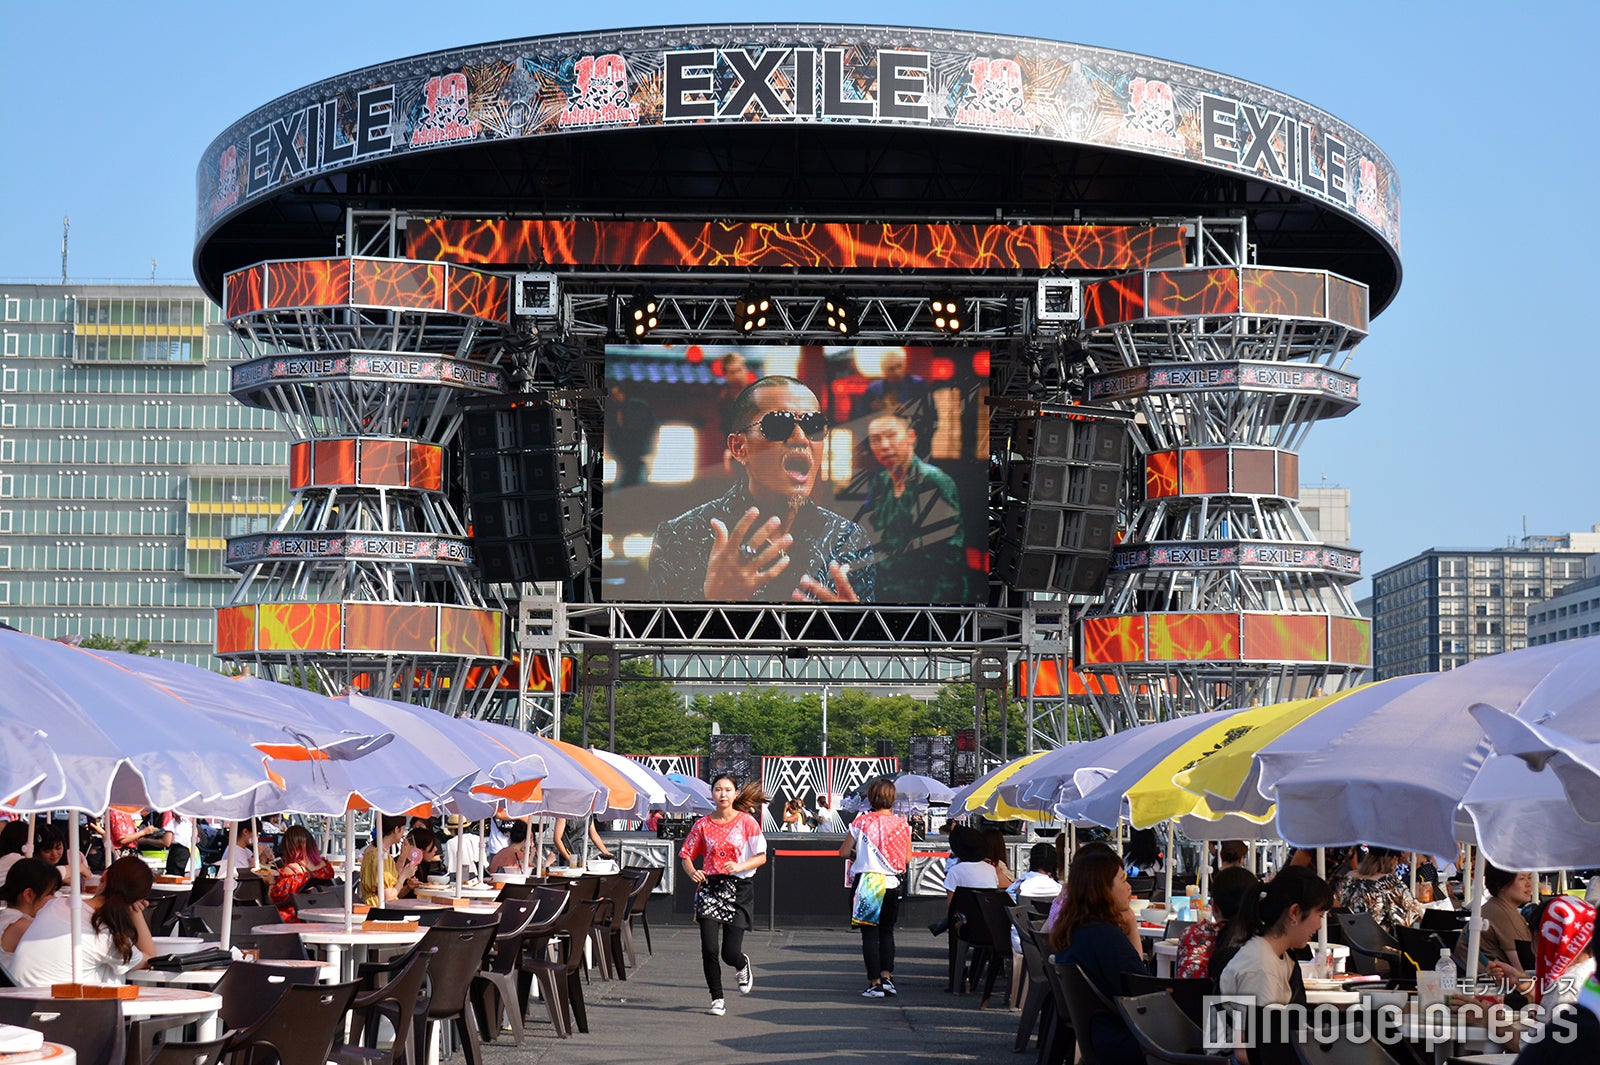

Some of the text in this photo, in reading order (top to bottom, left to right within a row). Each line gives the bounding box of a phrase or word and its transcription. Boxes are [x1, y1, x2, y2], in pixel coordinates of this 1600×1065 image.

[662, 47, 930, 123] EXILE
[247, 84, 395, 197] EXILE
[1200, 92, 1349, 204] EXILE
[288, 360, 331, 375] EXILE
[372, 360, 419, 375] EXILE
[454, 367, 487, 384] EXILE
[1171, 370, 1218, 385] EXILE
[1258, 370, 1301, 386] EXILE
[1104, 376, 1136, 392] EXILE
[283, 540, 327, 553] EXILE
[367, 541, 415, 555] EXILE
[449, 545, 474, 559] EXIL
[1112, 551, 1137, 566] XILE
[1171, 549, 1218, 563] EXILE
[1258, 549, 1302, 563] EXILE
[1567, 921, 1595, 954] RYUTO
